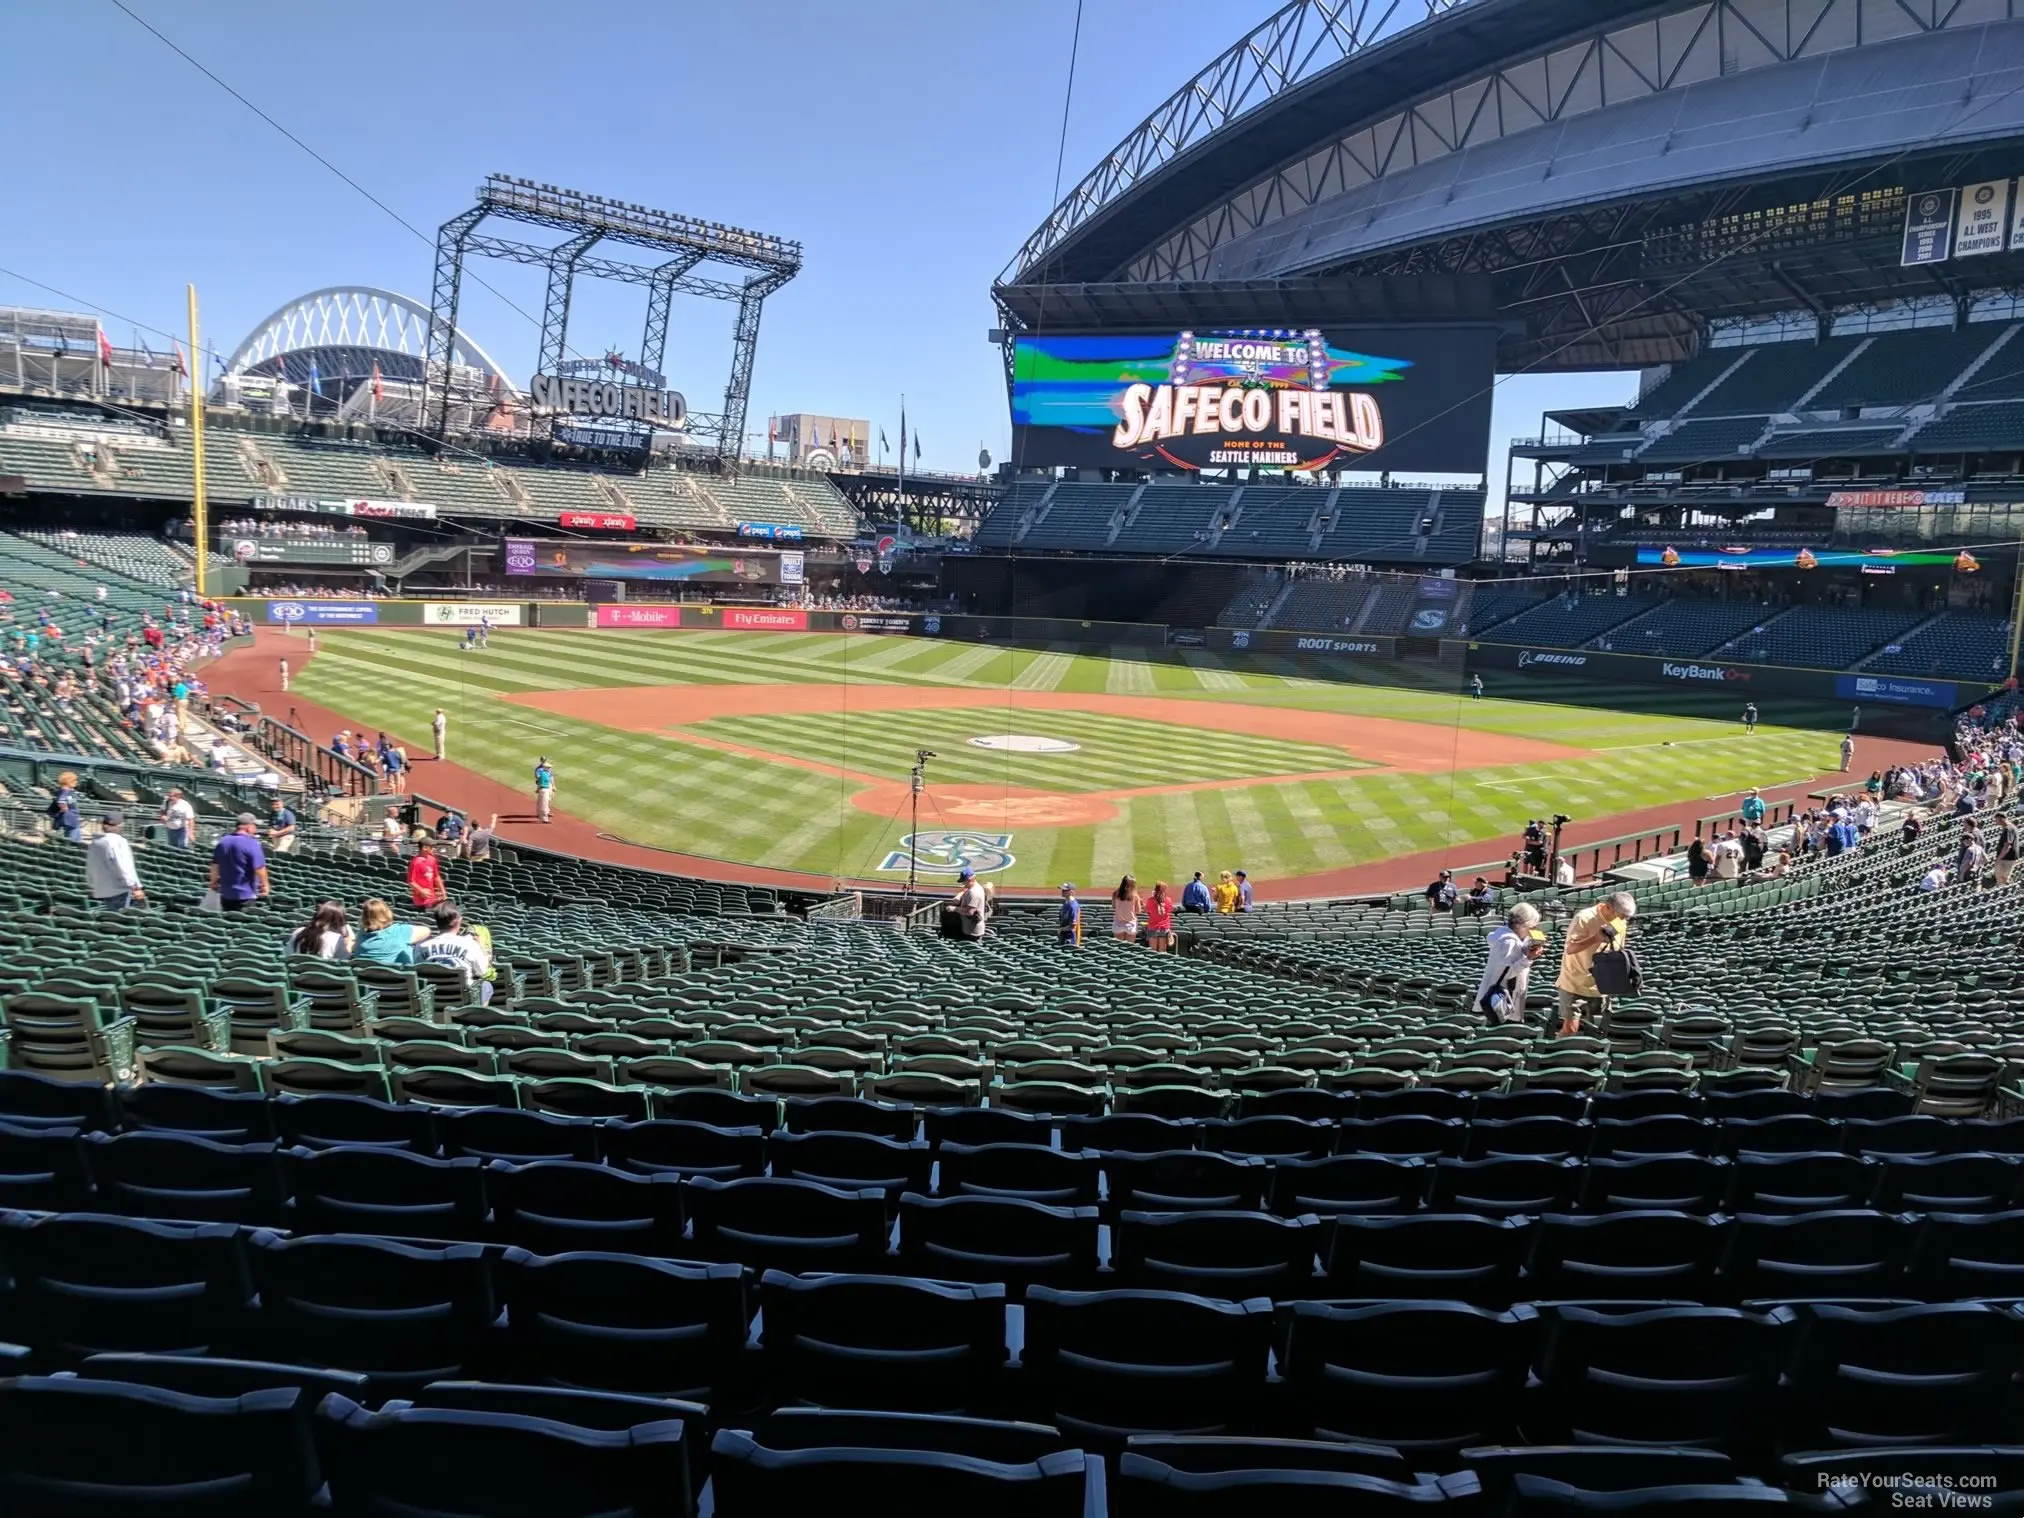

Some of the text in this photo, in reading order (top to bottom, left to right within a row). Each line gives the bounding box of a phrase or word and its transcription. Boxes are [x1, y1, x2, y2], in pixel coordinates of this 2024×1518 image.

[1973, 209, 1992, 220] 1995
[1977, 222, 1999, 235] WEST
[1957, 236, 2001, 251] CHAMPIONS
[1195, 341, 1309, 365] WELCOME TO
[531, 374, 687, 431] SAFECO FIELD
[1112, 383, 1384, 450] SAFECO FIELD
[594, 433, 605, 444] TO
[606, 433, 621, 446] THE
[622, 434, 645, 448] BLUE
[1210, 450, 1298, 464] SEATTLE MARINERS
[253, 496, 319, 512] EDGARS
[482, 608, 510, 616] HUTCH
[735, 613, 796, 625] Fly Emirates
[1297, 638, 1377, 652] ROOT SPORTS
[1534, 653, 1587, 665] BOEING
[1663, 662, 1725, 680] KeyBank
